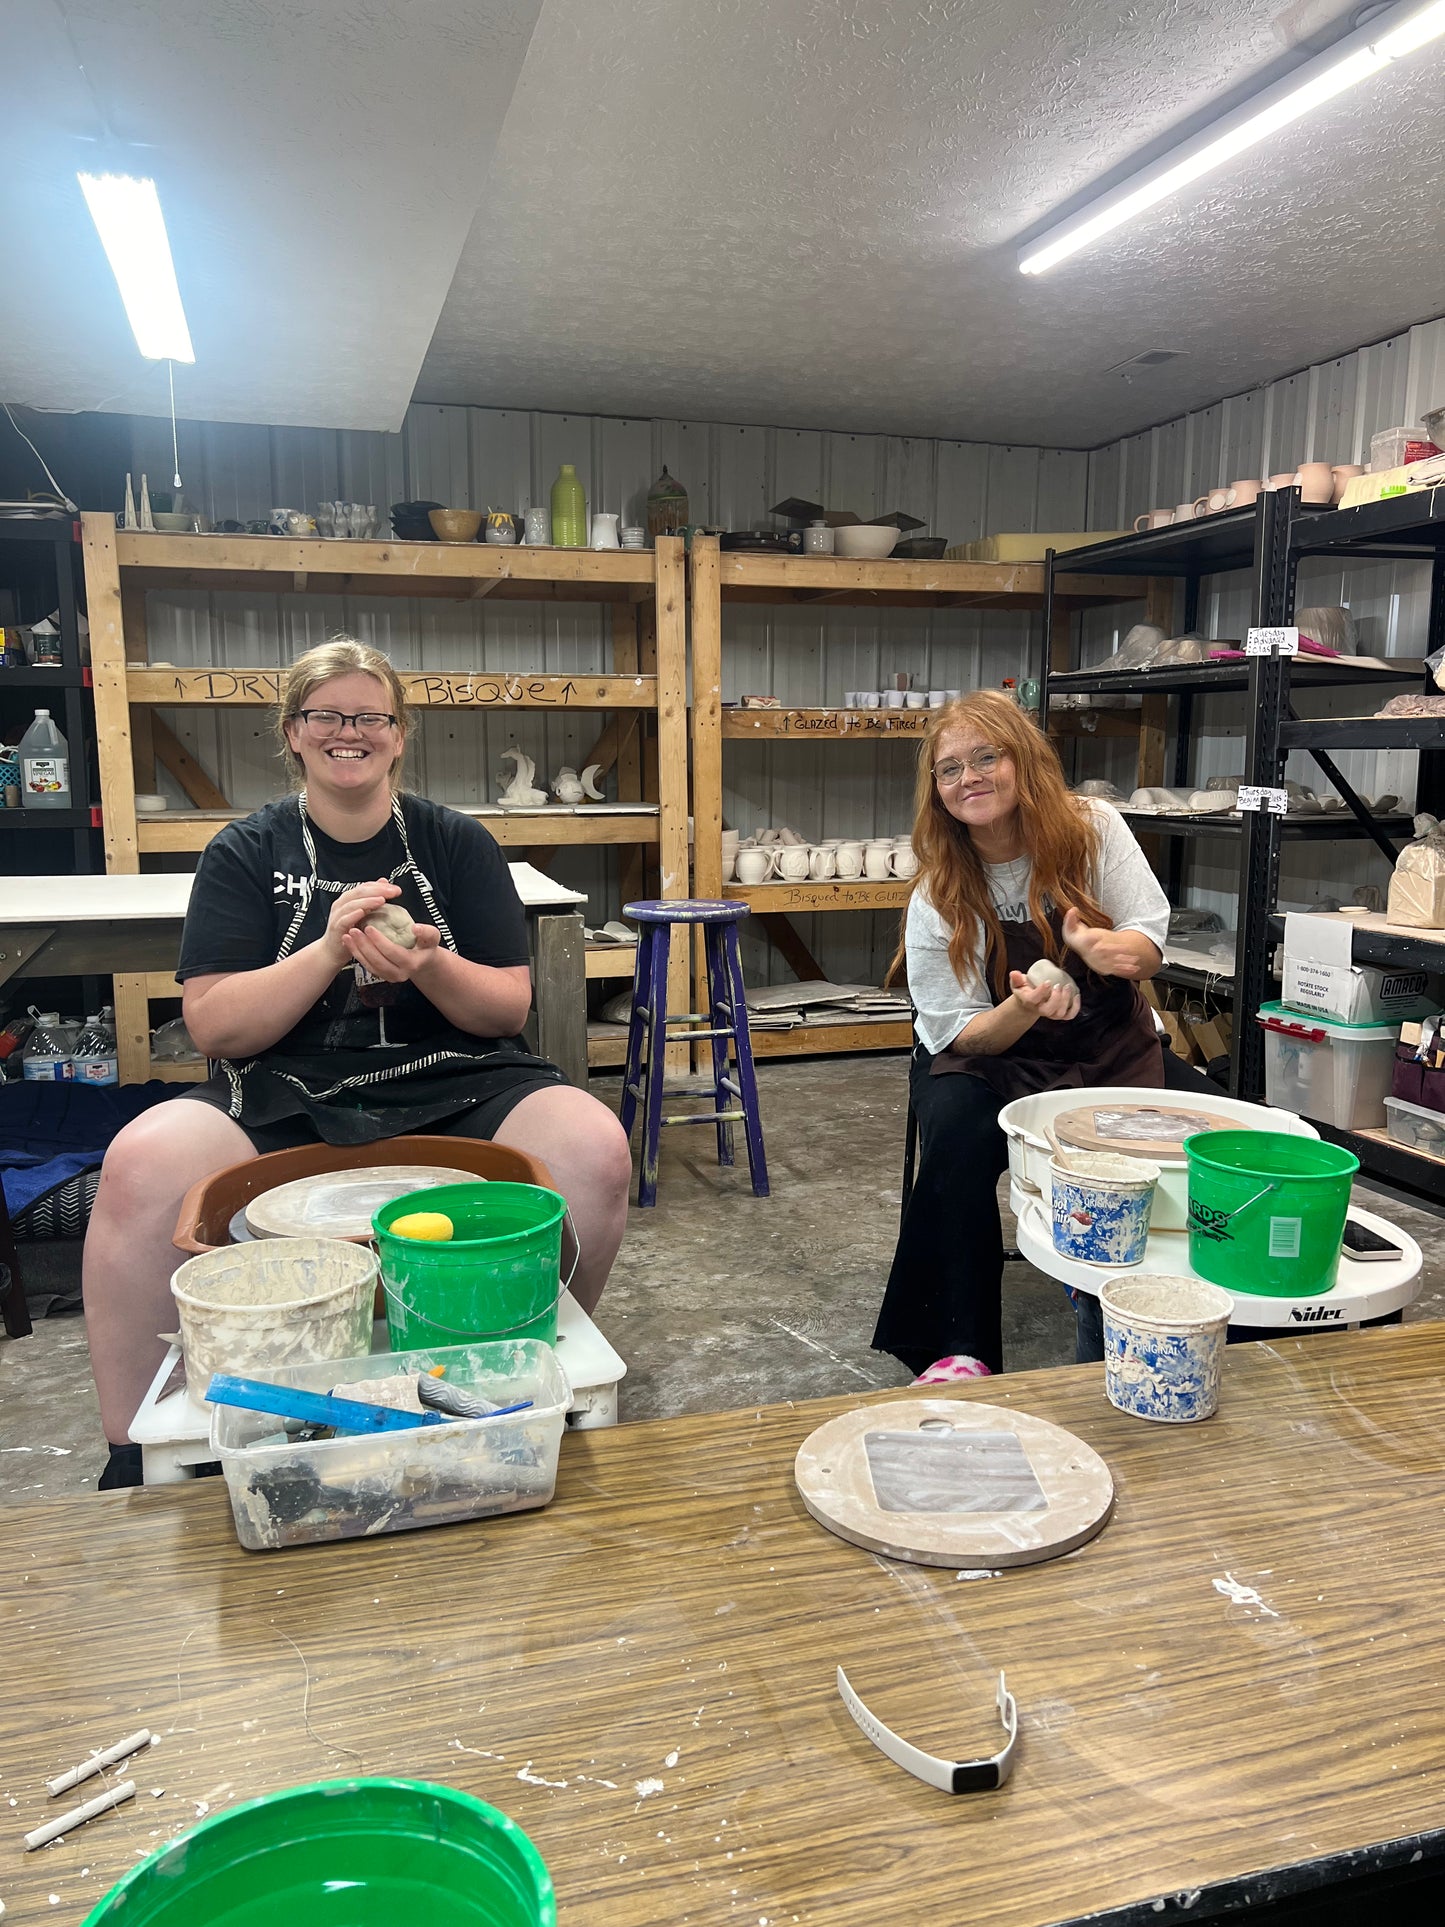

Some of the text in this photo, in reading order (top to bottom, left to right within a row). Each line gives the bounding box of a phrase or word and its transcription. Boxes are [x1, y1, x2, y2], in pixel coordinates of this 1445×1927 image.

[194, 672, 280, 701] DRY
[874, 890, 908, 902] GLAZ
[1297, 980, 1329, 993] ROTATE STOCK
[1383, 974, 1422, 996] AMACO
[1300, 987, 1325, 998] REGULARLY
[1296, 1001, 1311, 1010] MADE
[1318, 1006, 1329, 1014] USA
[1288, 1306, 1347, 1322] Nidec
[1135, 1343, 1181, 1356] ORIGINAL
